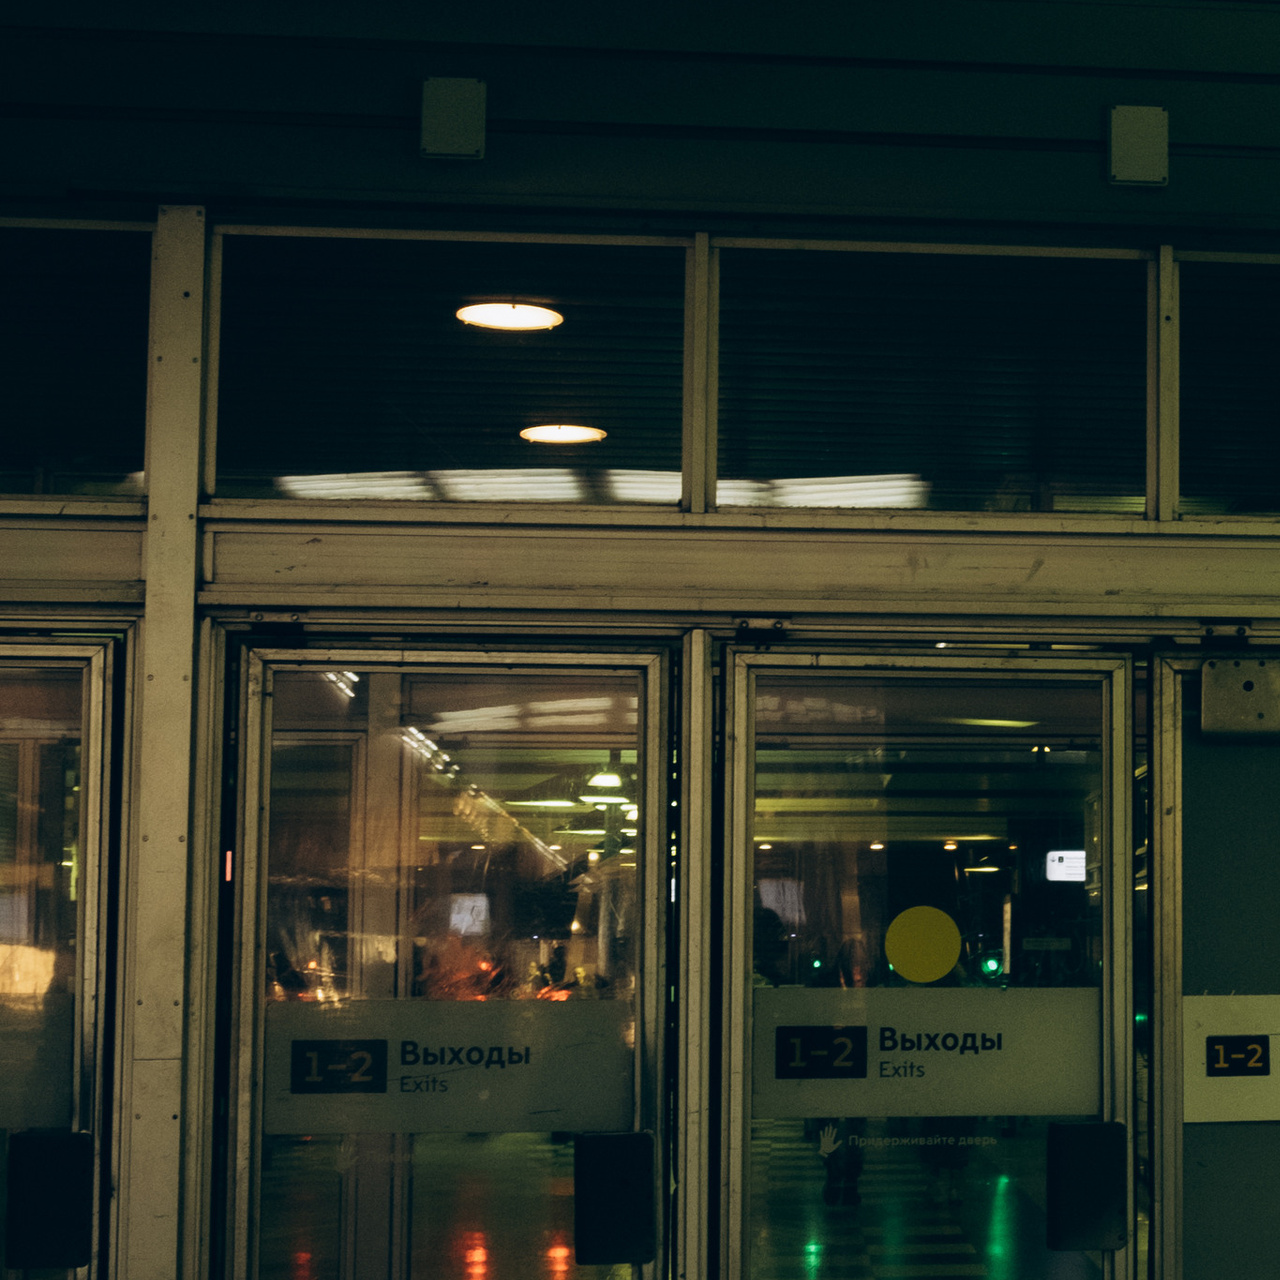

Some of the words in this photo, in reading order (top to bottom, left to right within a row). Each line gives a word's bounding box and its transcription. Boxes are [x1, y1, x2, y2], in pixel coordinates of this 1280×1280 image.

[788, 1037, 854, 1068] 1-2
[879, 1027, 1002, 1055] Выходы
[1213, 1043, 1264, 1069] 1-2
[304, 1051, 374, 1083] 1-2
[400, 1040, 531, 1068] Выходы
[879, 1061, 925, 1078] Exits
[400, 1076, 448, 1093] Exits
[848, 1135, 955, 1147] Придерживайте
[958, 1135, 998, 1147] дверь
